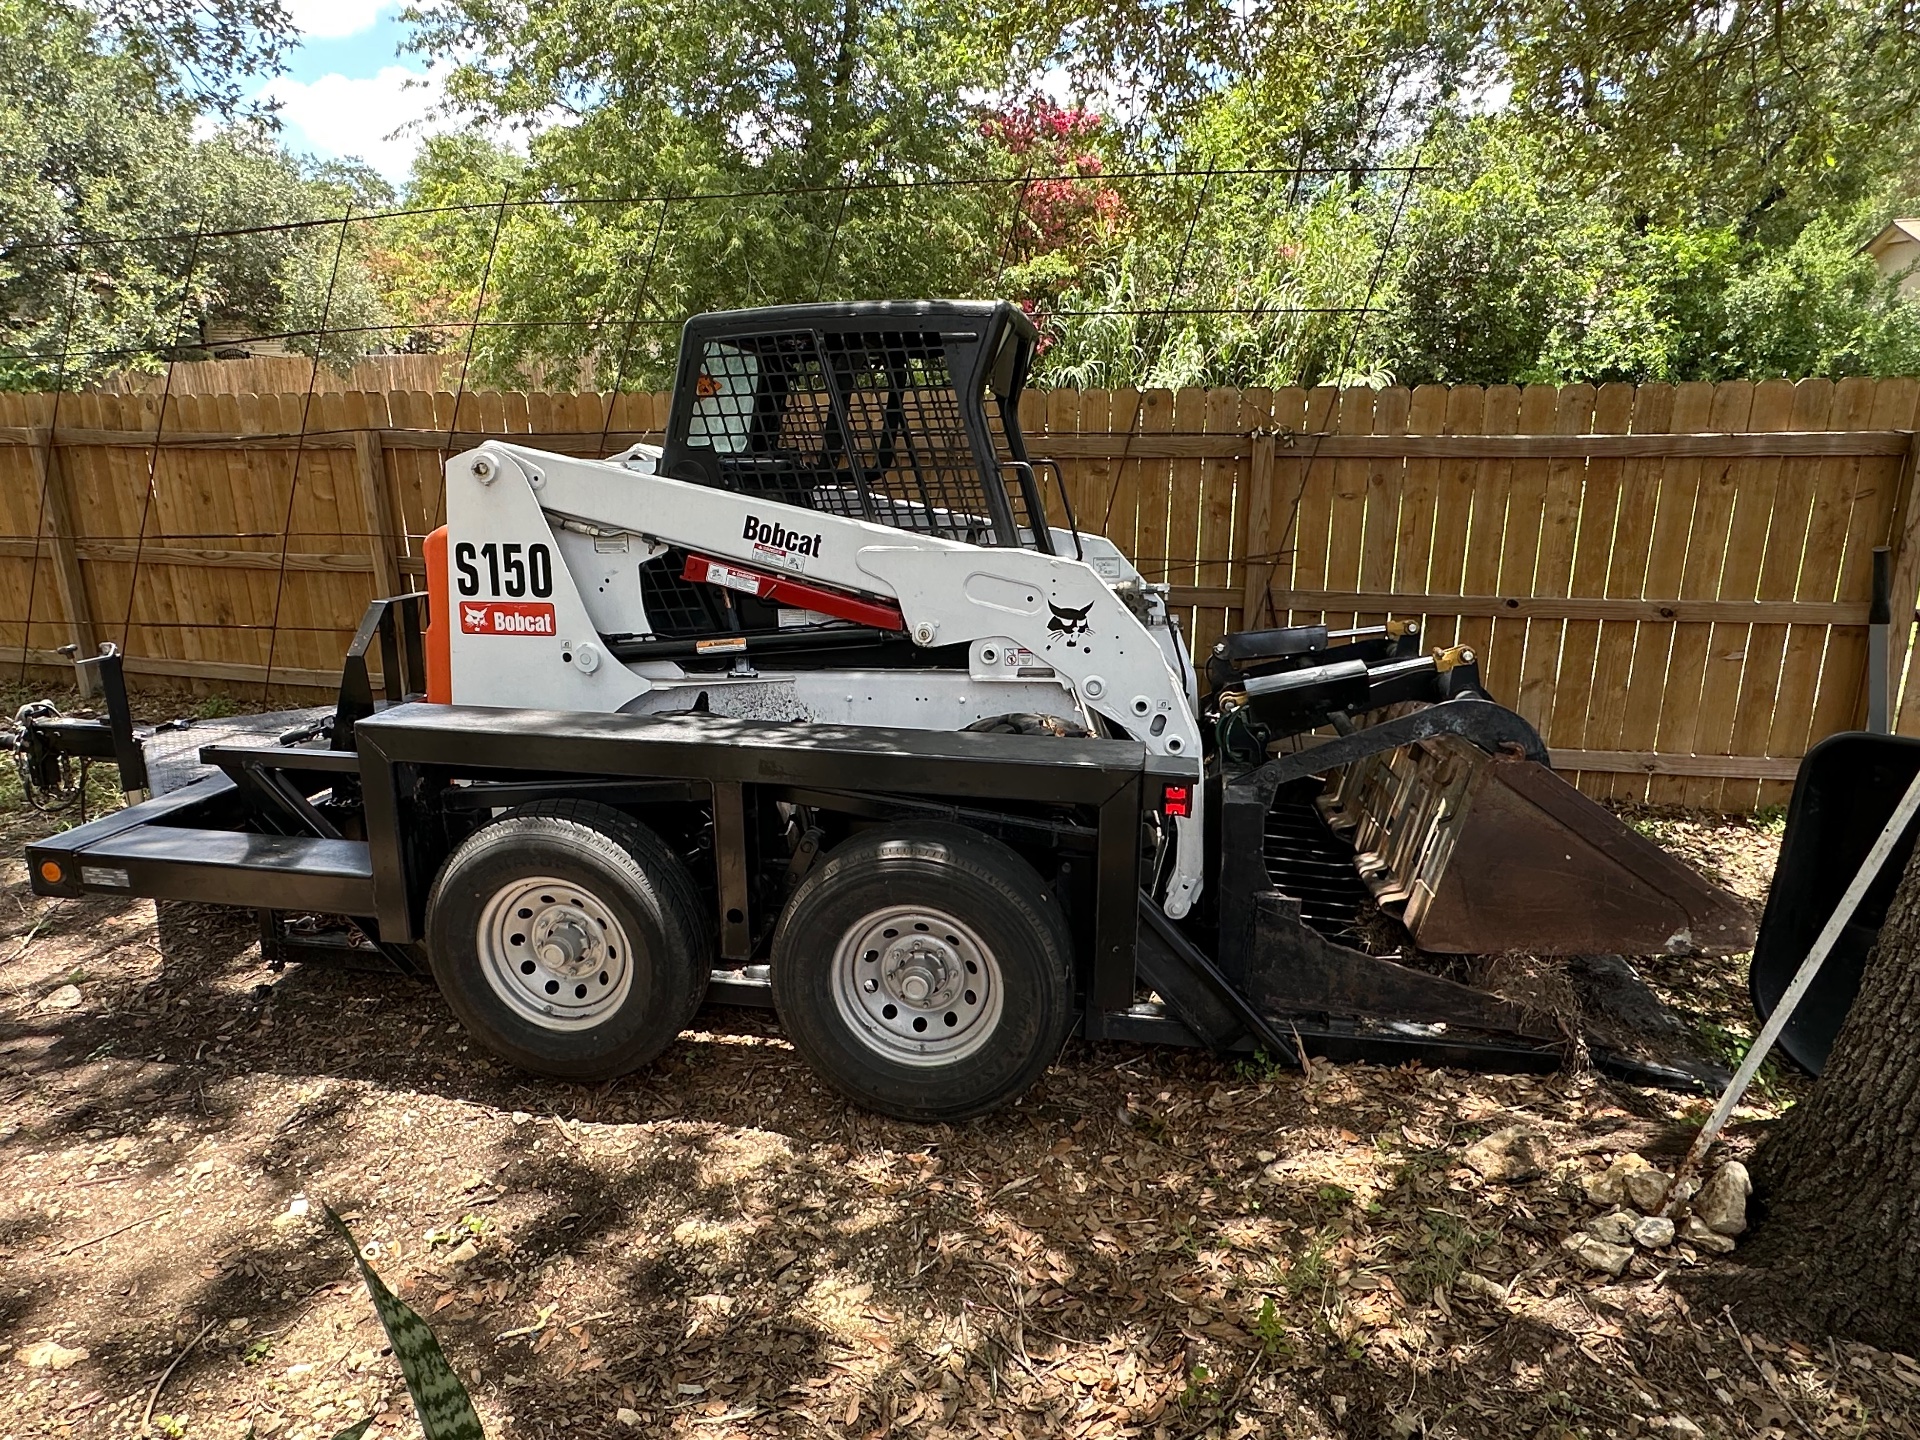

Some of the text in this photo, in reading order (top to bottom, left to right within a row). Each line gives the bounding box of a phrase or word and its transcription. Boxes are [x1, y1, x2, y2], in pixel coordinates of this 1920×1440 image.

[743, 515, 822, 558] Bobcat
[455, 542, 553, 598] S150
[494, 611, 552, 633] Bobcat
